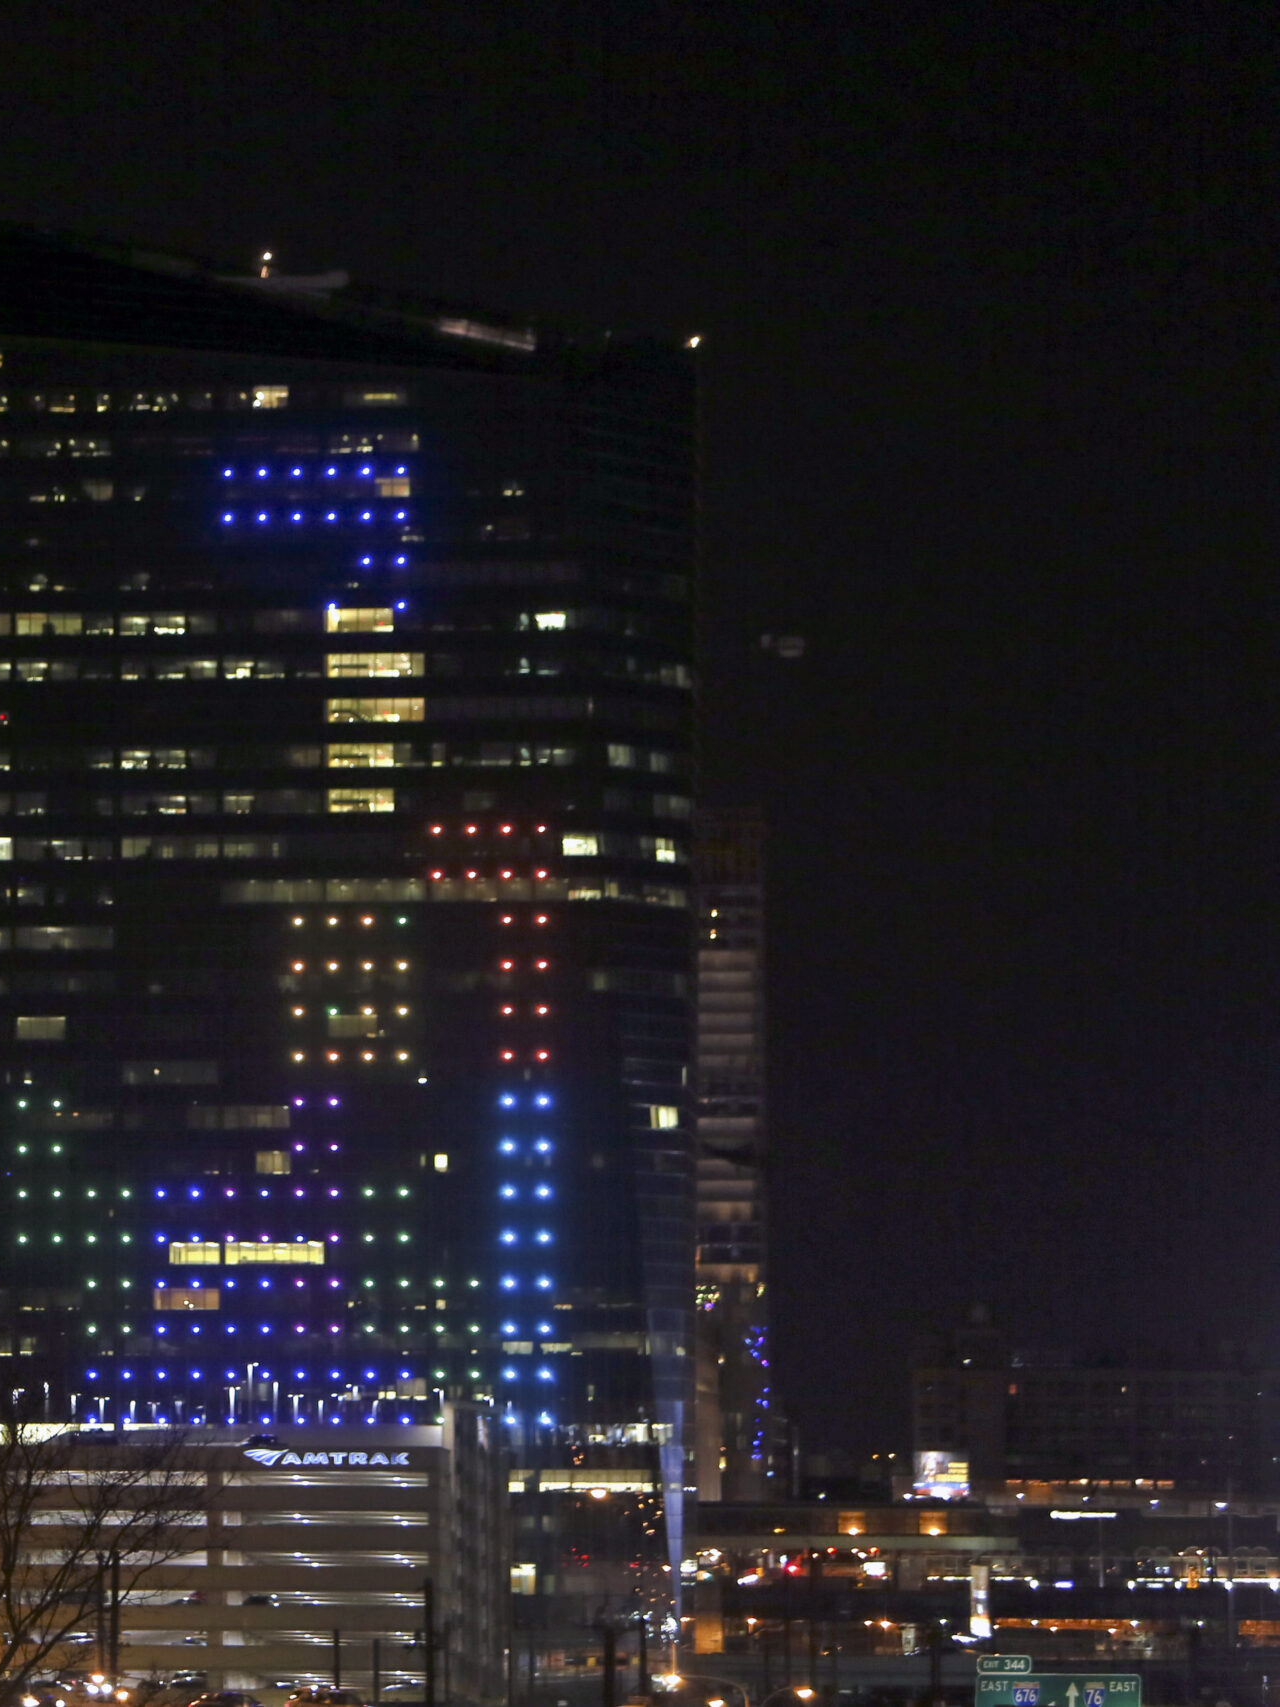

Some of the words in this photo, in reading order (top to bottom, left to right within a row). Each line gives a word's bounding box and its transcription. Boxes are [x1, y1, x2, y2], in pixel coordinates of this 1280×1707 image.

[281, 1452, 410, 1465] AMTRAK
[983, 1660, 1000, 1668] EXIT
[1004, 1659, 1025, 1670] 344
[980, 1681, 1009, 1691] EAST
[1109, 1681, 1137, 1692] EAST
[1015, 1689, 1037, 1703] 676
[1086, 1690, 1102, 1705] 76
